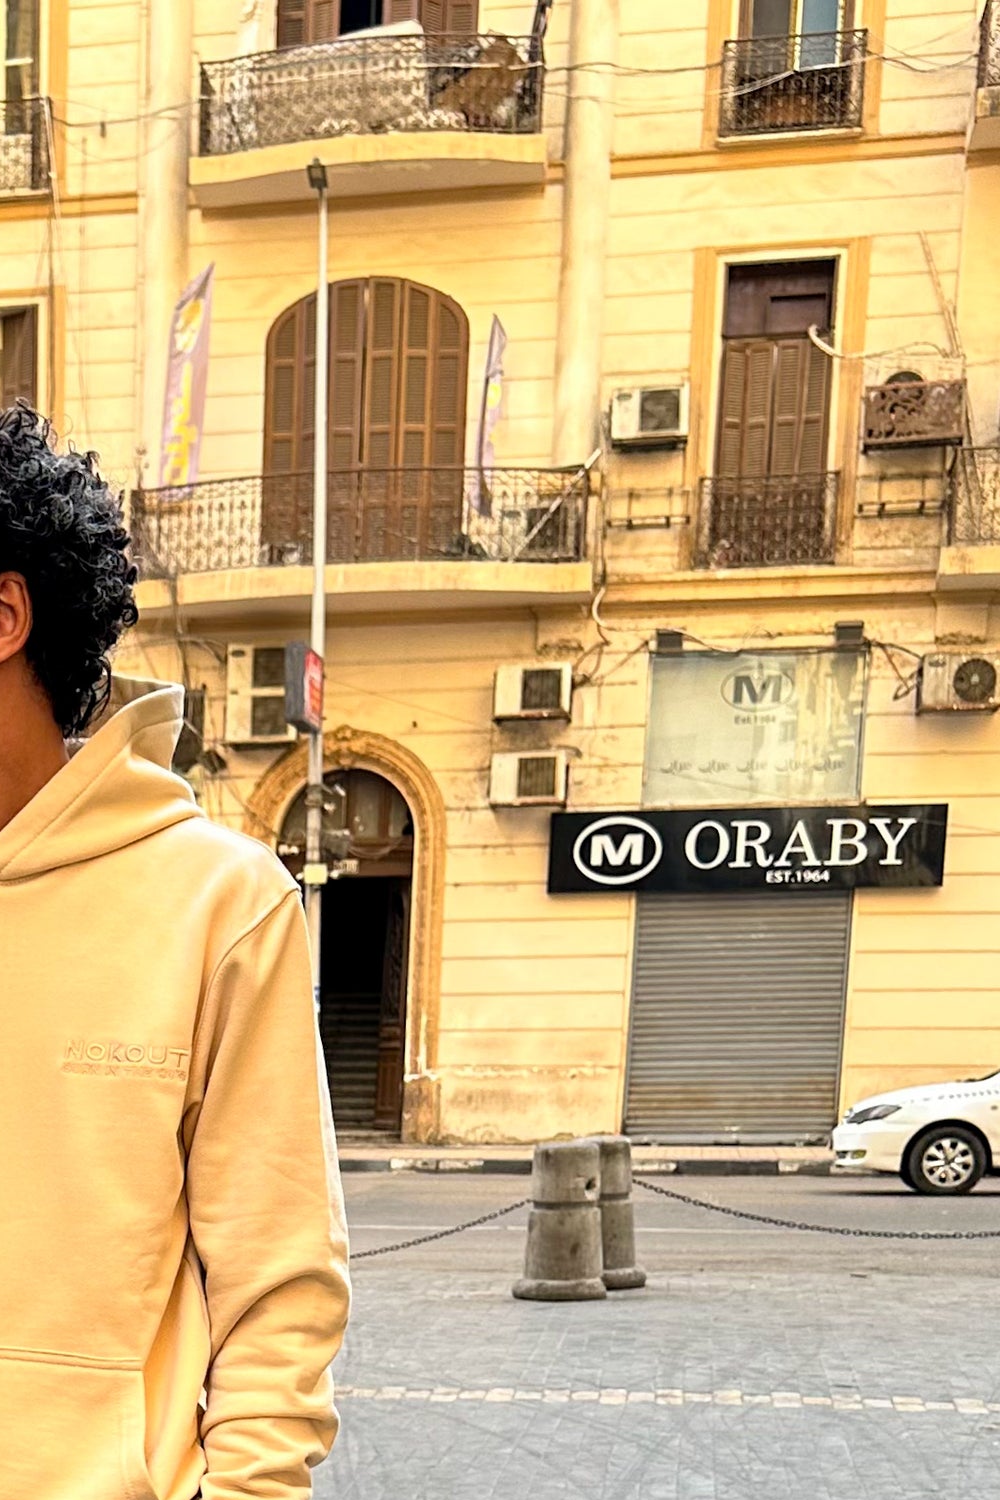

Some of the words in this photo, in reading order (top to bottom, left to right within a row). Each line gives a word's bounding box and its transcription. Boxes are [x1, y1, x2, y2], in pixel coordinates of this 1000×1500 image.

[732, 674, 783, 705] M
[589, 833, 644, 868] M
[684, 817, 917, 870] ORABY
[765, 869, 831, 884] EST.1964
[64, 1040, 190, 1068] NOKOUT
